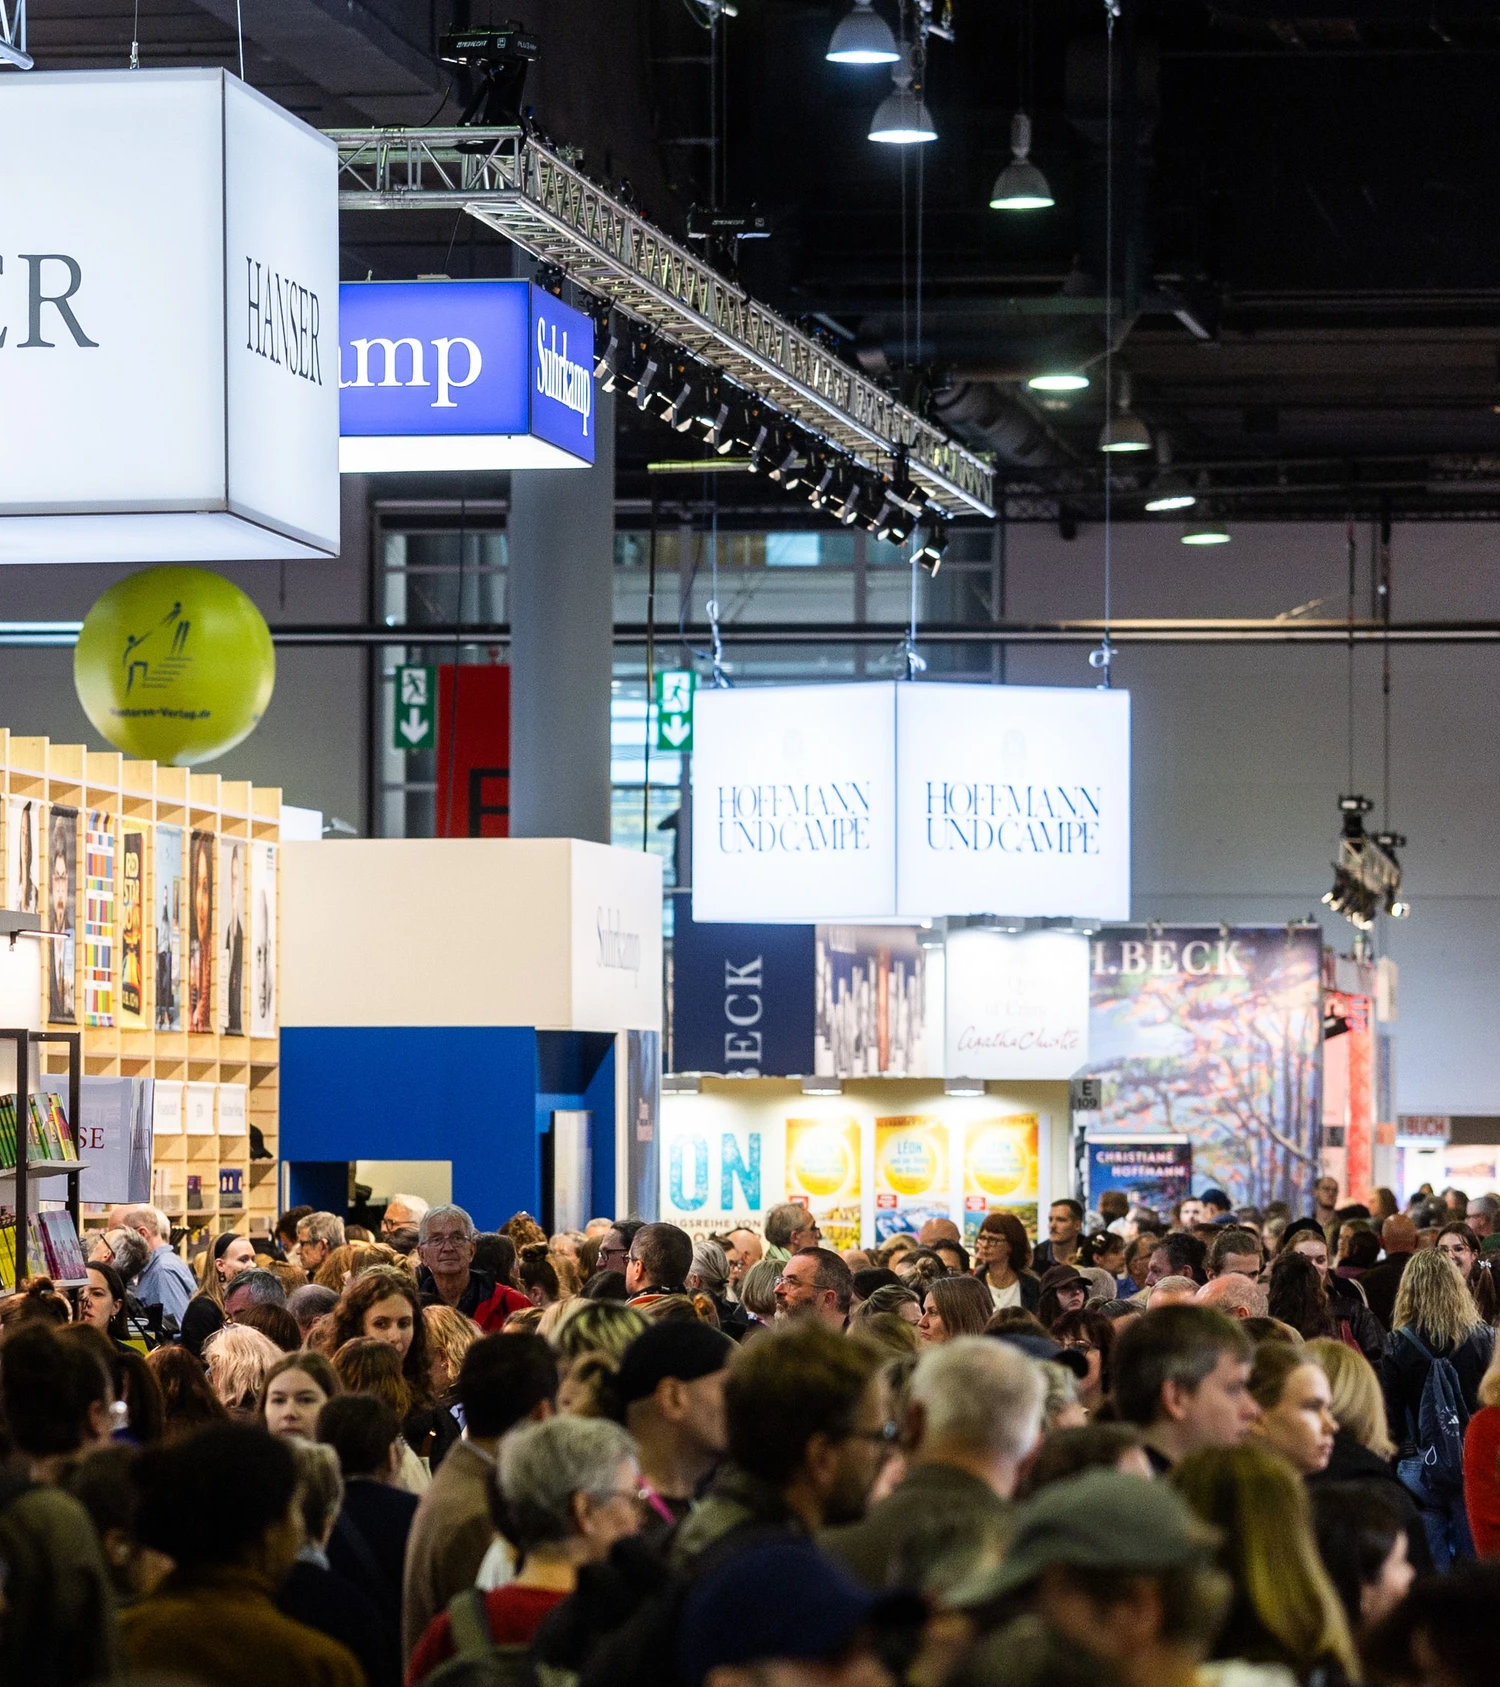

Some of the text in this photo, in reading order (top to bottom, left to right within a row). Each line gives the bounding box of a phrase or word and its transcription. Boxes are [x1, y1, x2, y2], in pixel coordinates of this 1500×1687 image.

[246, 256, 322, 385] HANSER
[537, 317, 591, 436] Suhrkamp
[718, 781, 871, 818] HOFFMANN
[925, 781, 1100, 818] HOFFMANN
[724, 955, 763, 1078] ECK
[1082, 1081, 1092, 1096] E
[669, 1133, 761, 1211] ON
[1095, 1151, 1175, 1163] CHRISTIANE
[734, 1220, 761, 1228] VON
